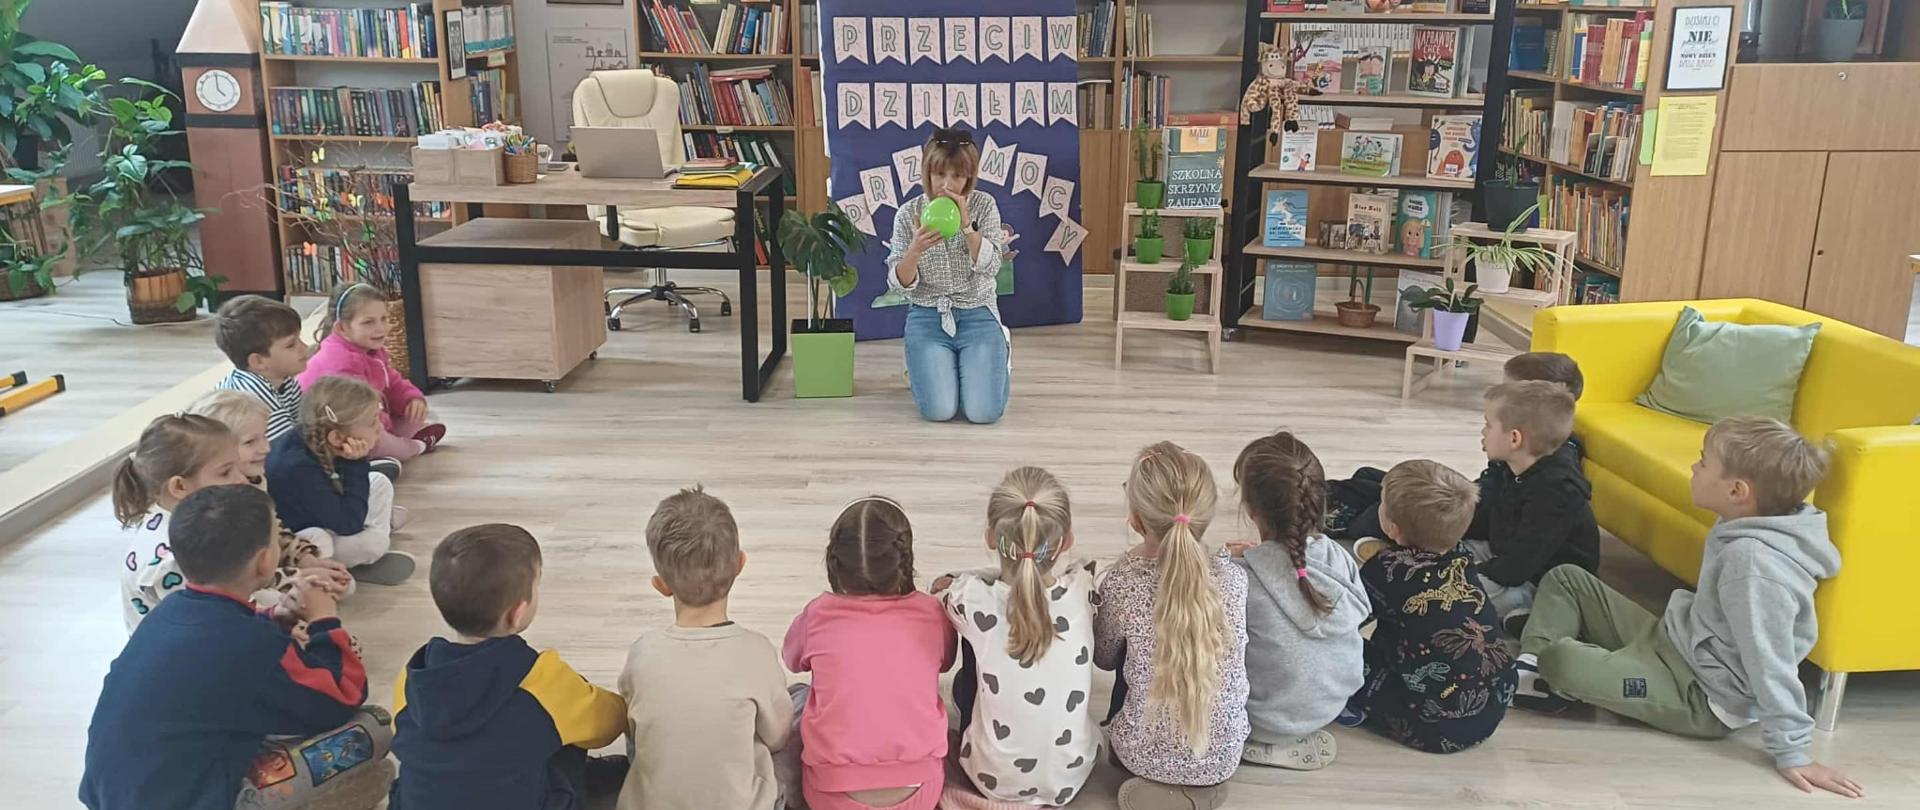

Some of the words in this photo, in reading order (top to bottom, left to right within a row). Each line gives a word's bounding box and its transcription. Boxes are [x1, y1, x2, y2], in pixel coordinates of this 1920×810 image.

[842, 24, 1073, 52] PRZECIW
[1688, 30, 1713, 42] NIE
[845, 89, 1073, 117] DZIAŁAM
[1171, 168, 1222, 181] SZKOLNA
